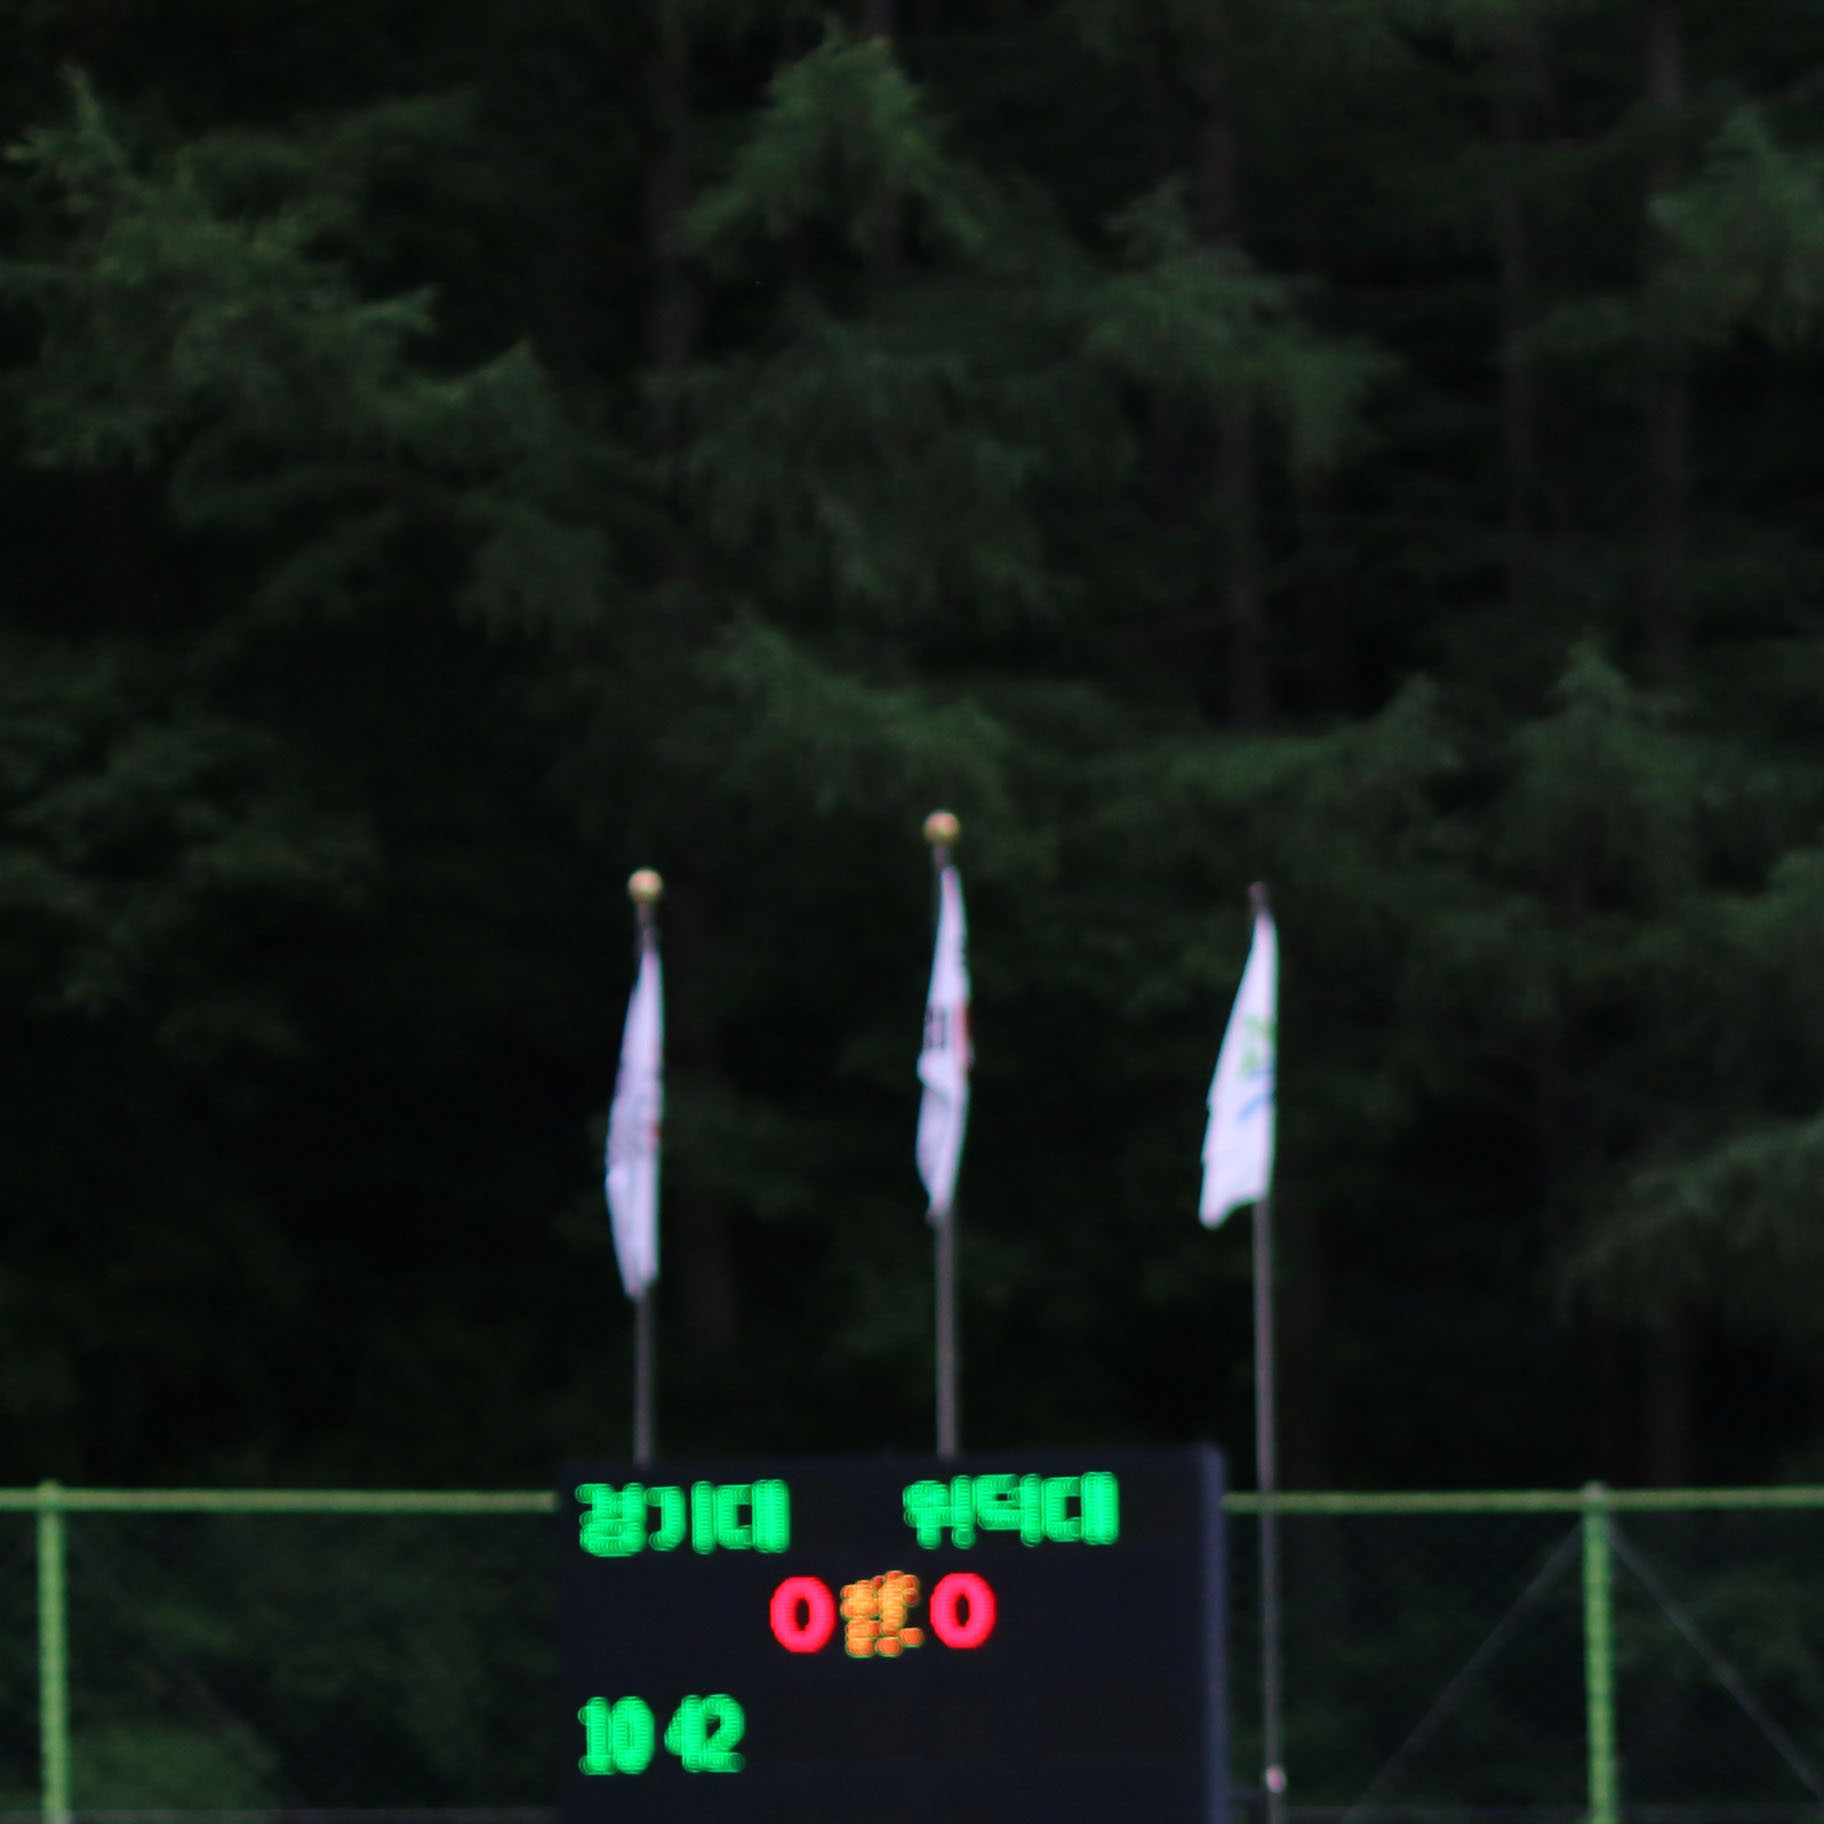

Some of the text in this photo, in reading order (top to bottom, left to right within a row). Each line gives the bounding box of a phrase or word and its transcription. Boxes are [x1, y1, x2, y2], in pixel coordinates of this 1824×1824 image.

[769, 1576, 836, 1653] 0
[930, 1572, 996, 1649] 0
[578, 1694, 745, 1776] 10 42
